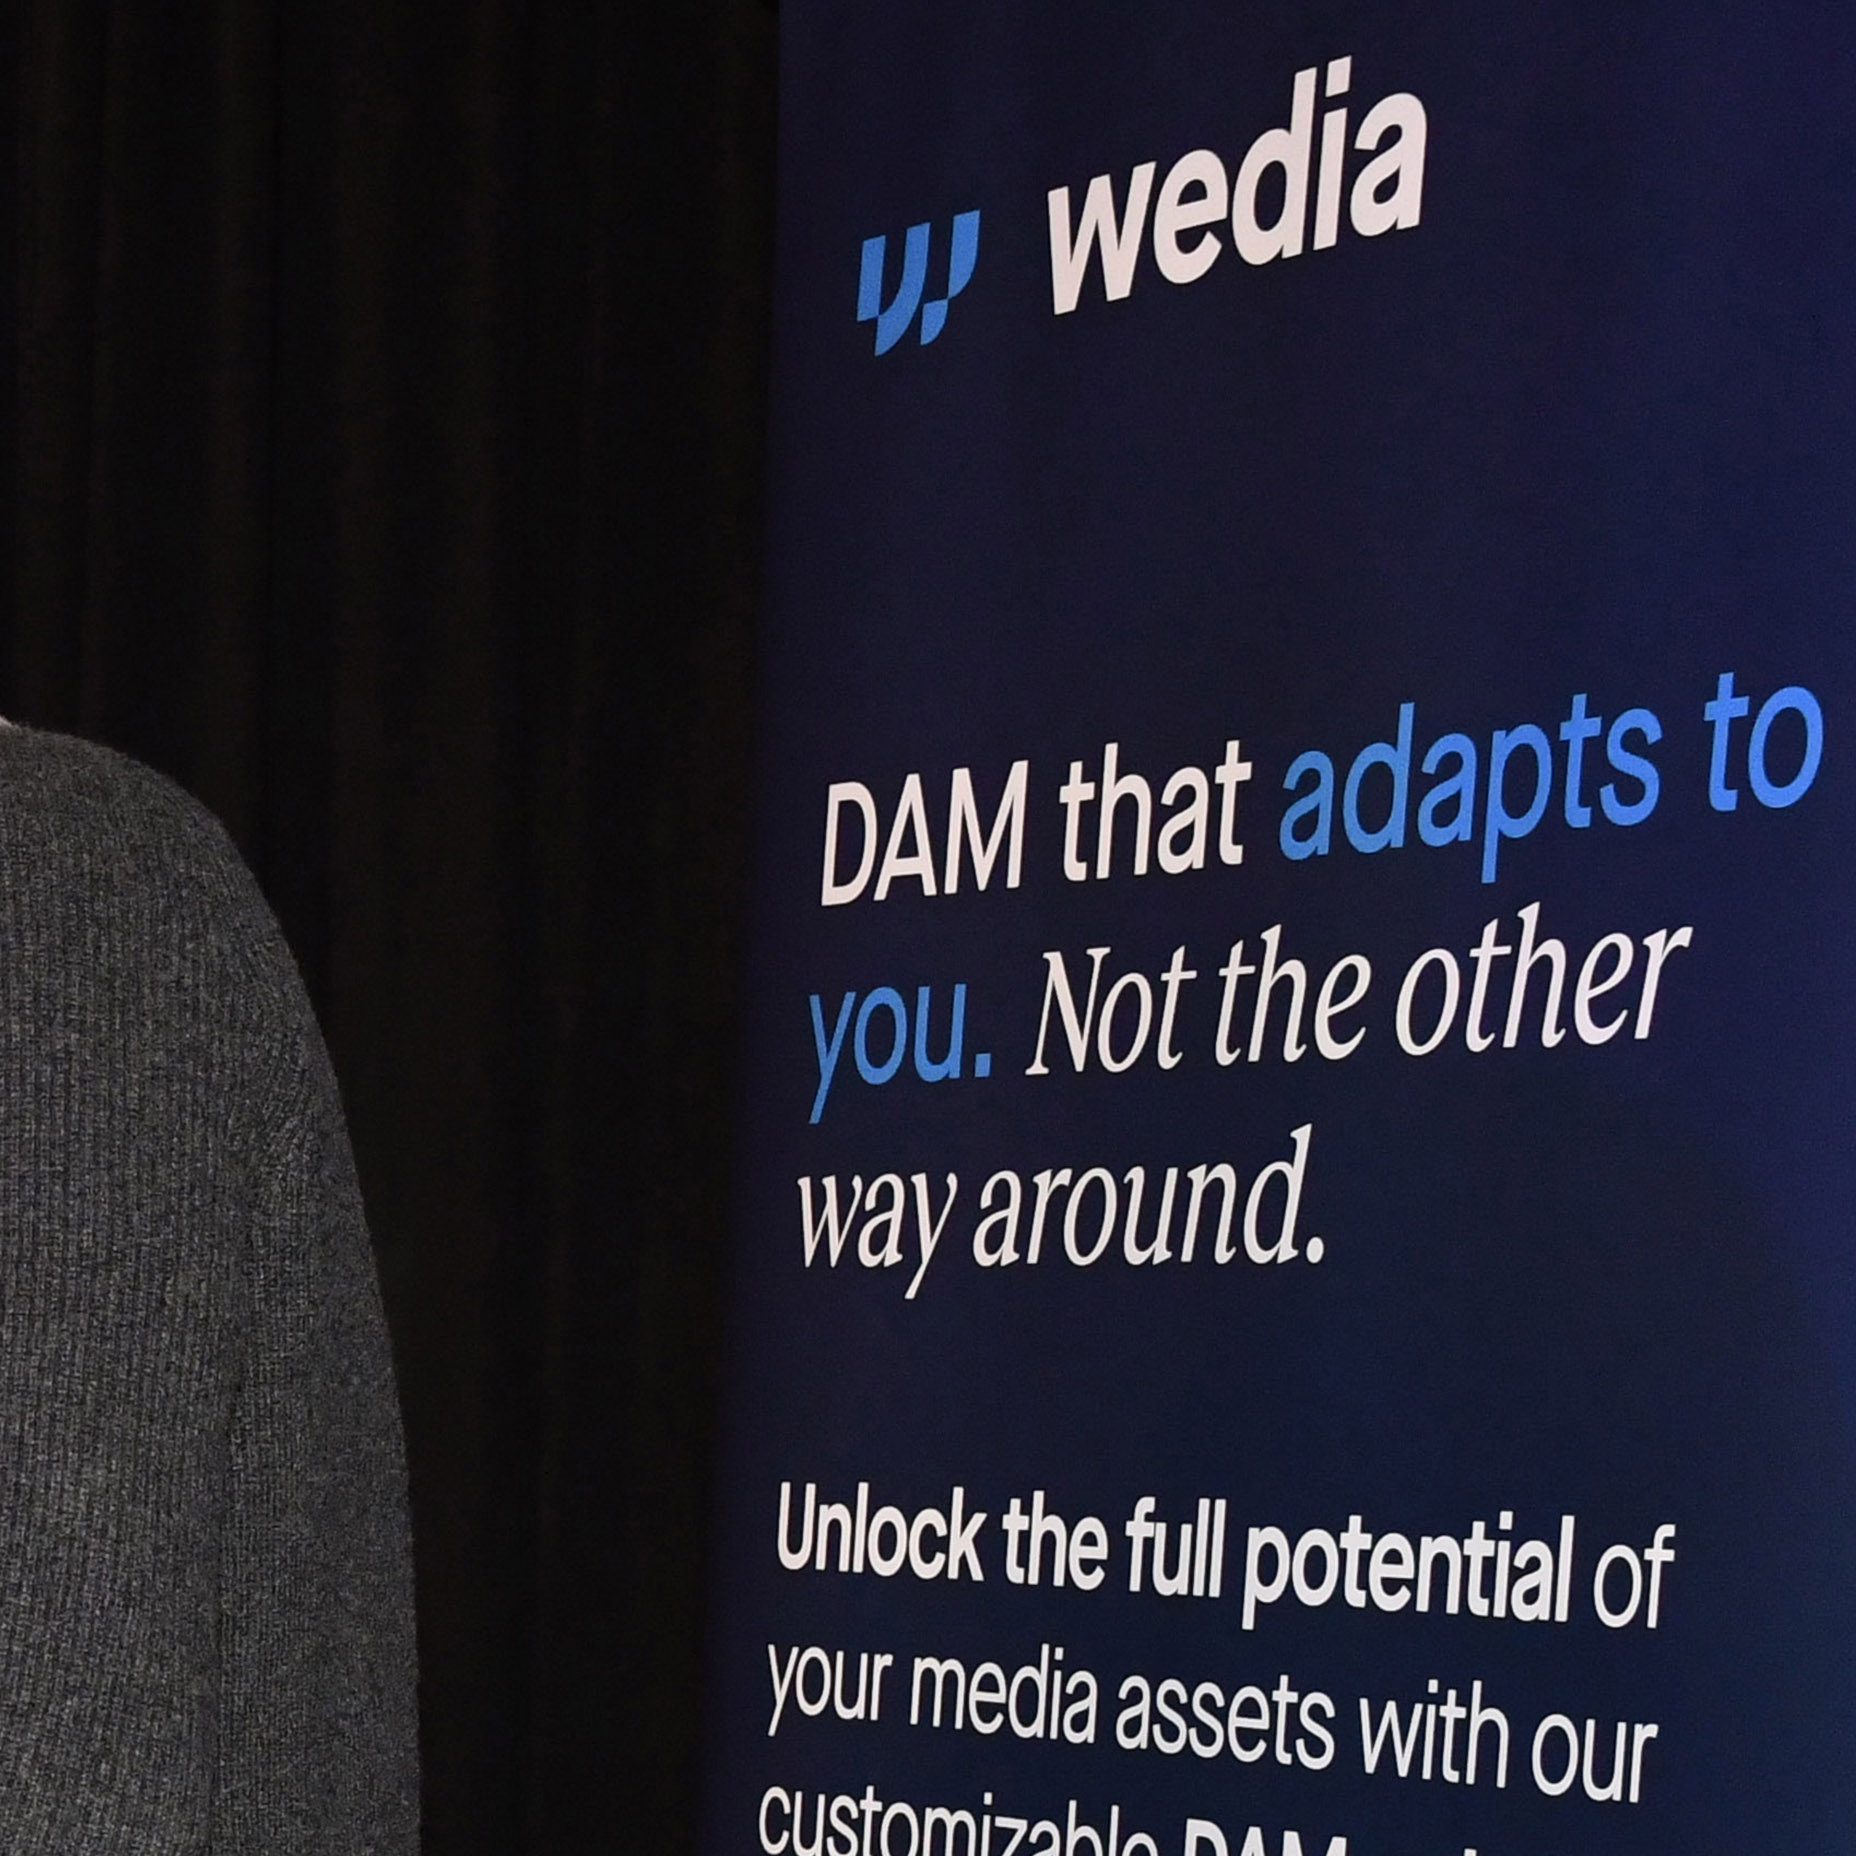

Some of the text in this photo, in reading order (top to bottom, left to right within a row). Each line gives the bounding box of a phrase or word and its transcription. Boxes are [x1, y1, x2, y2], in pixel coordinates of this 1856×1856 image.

[1048, 56, 1427, 314] wedia
[822, 672, 1823, 905] DAM that adapts to
[810, 902, 1693, 1124] you. Not the other
[798, 1124, 1324, 1299] way around.
[778, 1482, 1675, 1630] Unlock the full potential of
[768, 1644, 1658, 1803] your media assets with our
